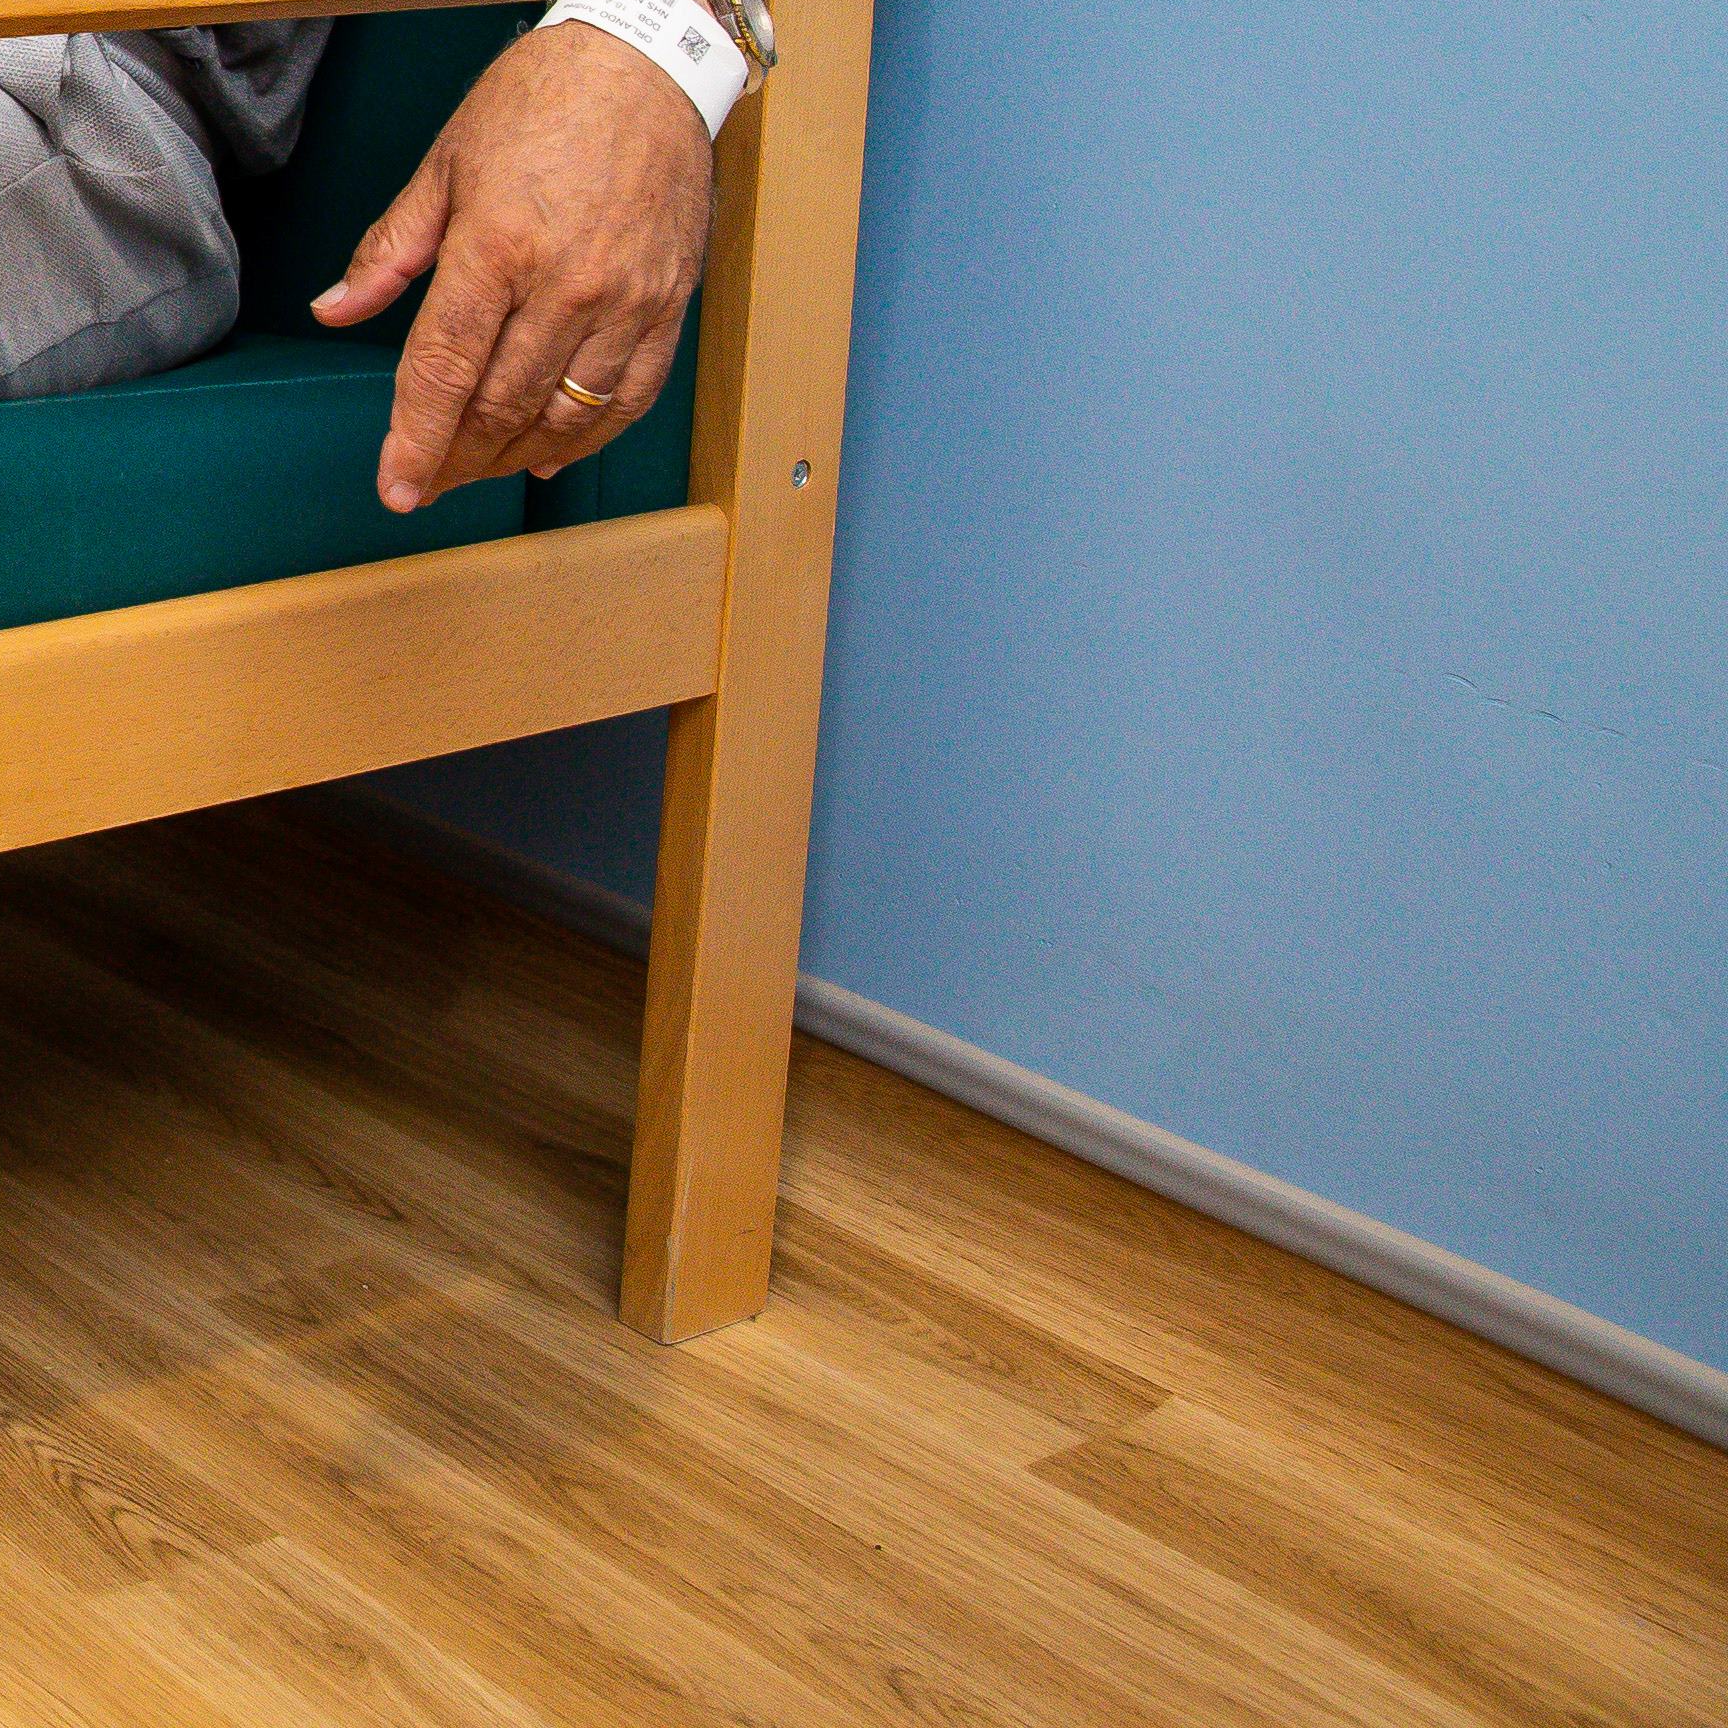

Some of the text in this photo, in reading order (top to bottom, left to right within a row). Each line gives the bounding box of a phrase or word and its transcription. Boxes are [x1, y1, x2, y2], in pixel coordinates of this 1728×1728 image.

[647, 1, 669, 19] NHS
[599, 10, 653, 44] ORLANDO
[638, 13, 661, 32] DOB
